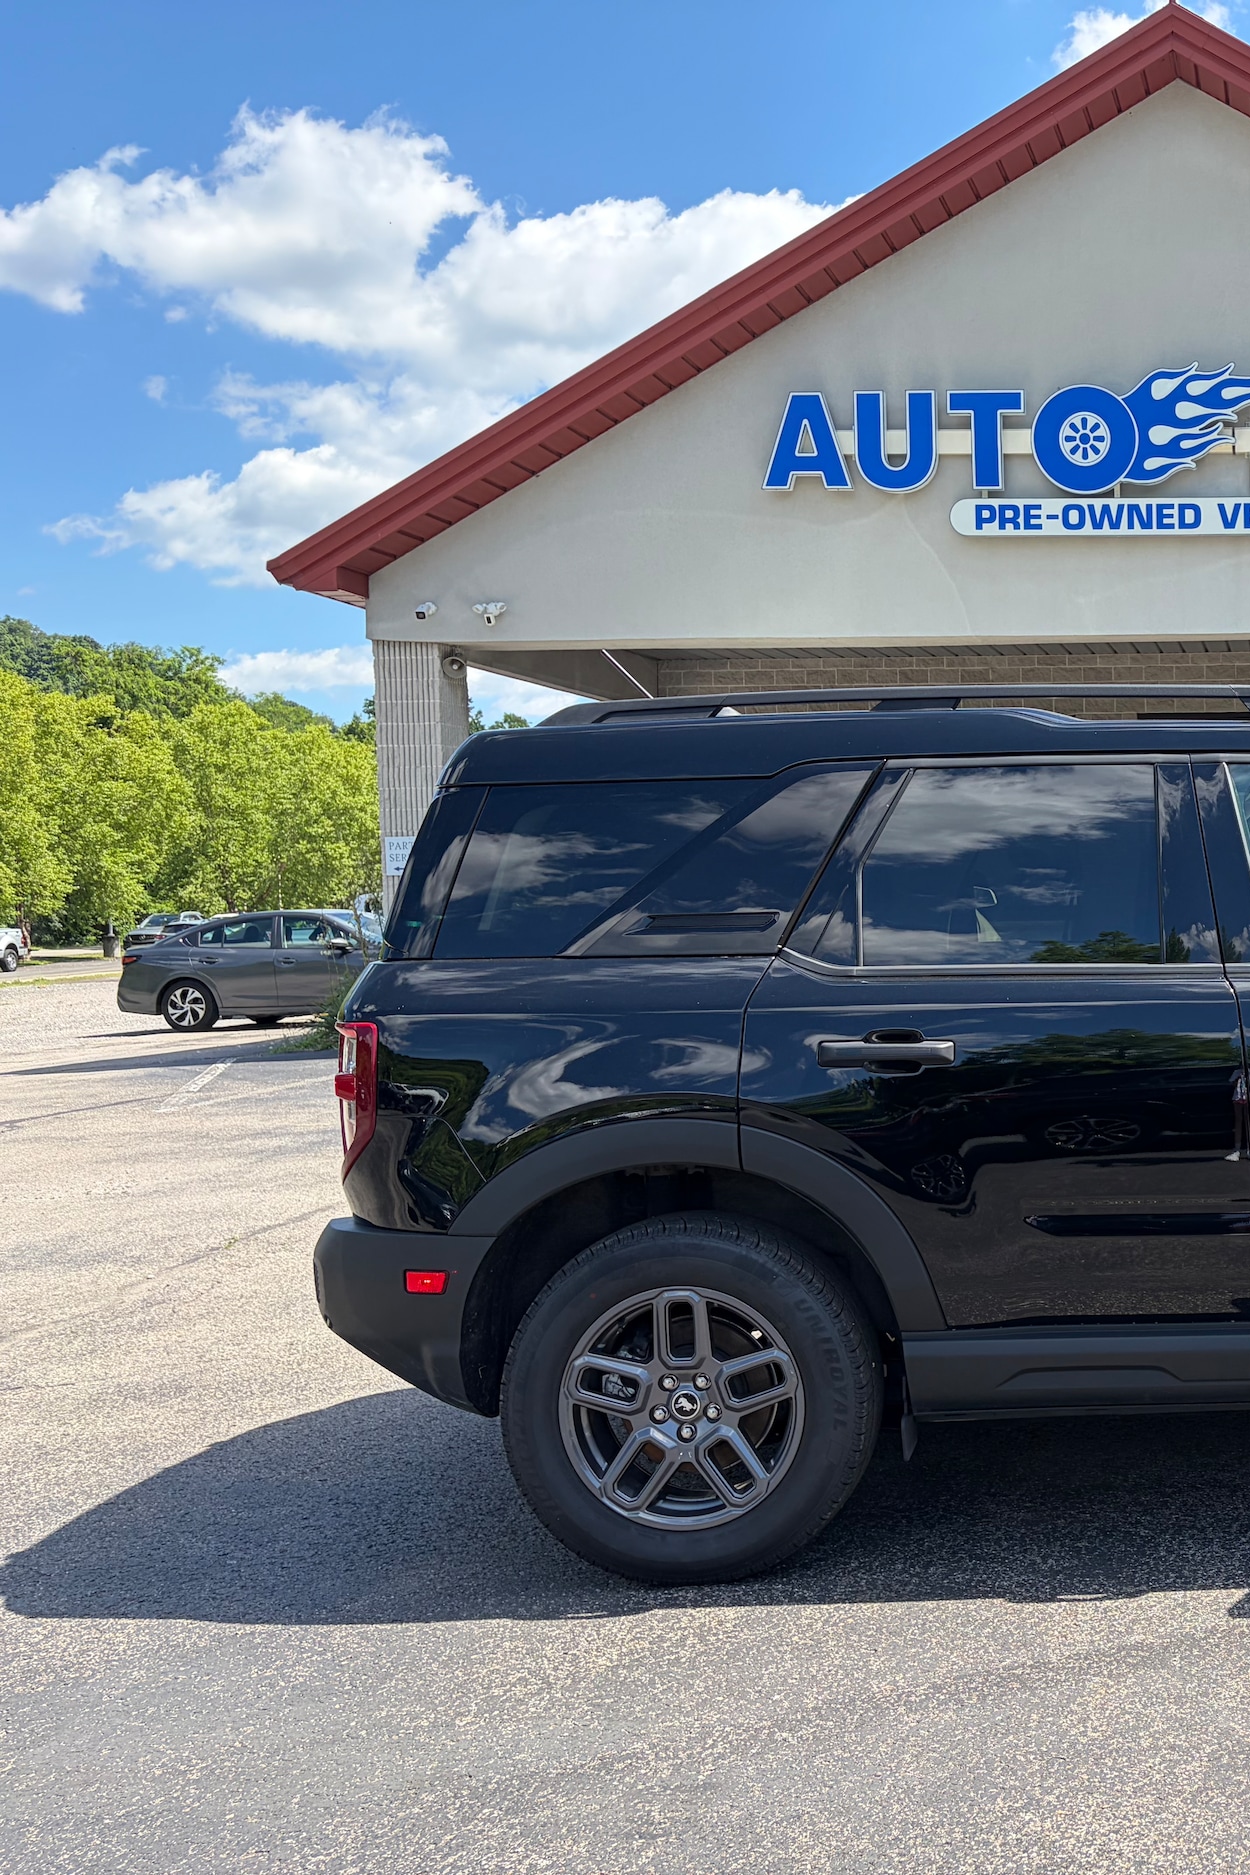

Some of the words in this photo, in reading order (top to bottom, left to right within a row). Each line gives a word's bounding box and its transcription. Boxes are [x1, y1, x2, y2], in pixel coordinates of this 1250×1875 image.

[762, 384, 1139, 494] AUTO
[974, 502, 1202, 531] PRE-OWNED
[389, 853, 409, 862] SER
[794, 1297, 849, 1431] UNIROYAL
